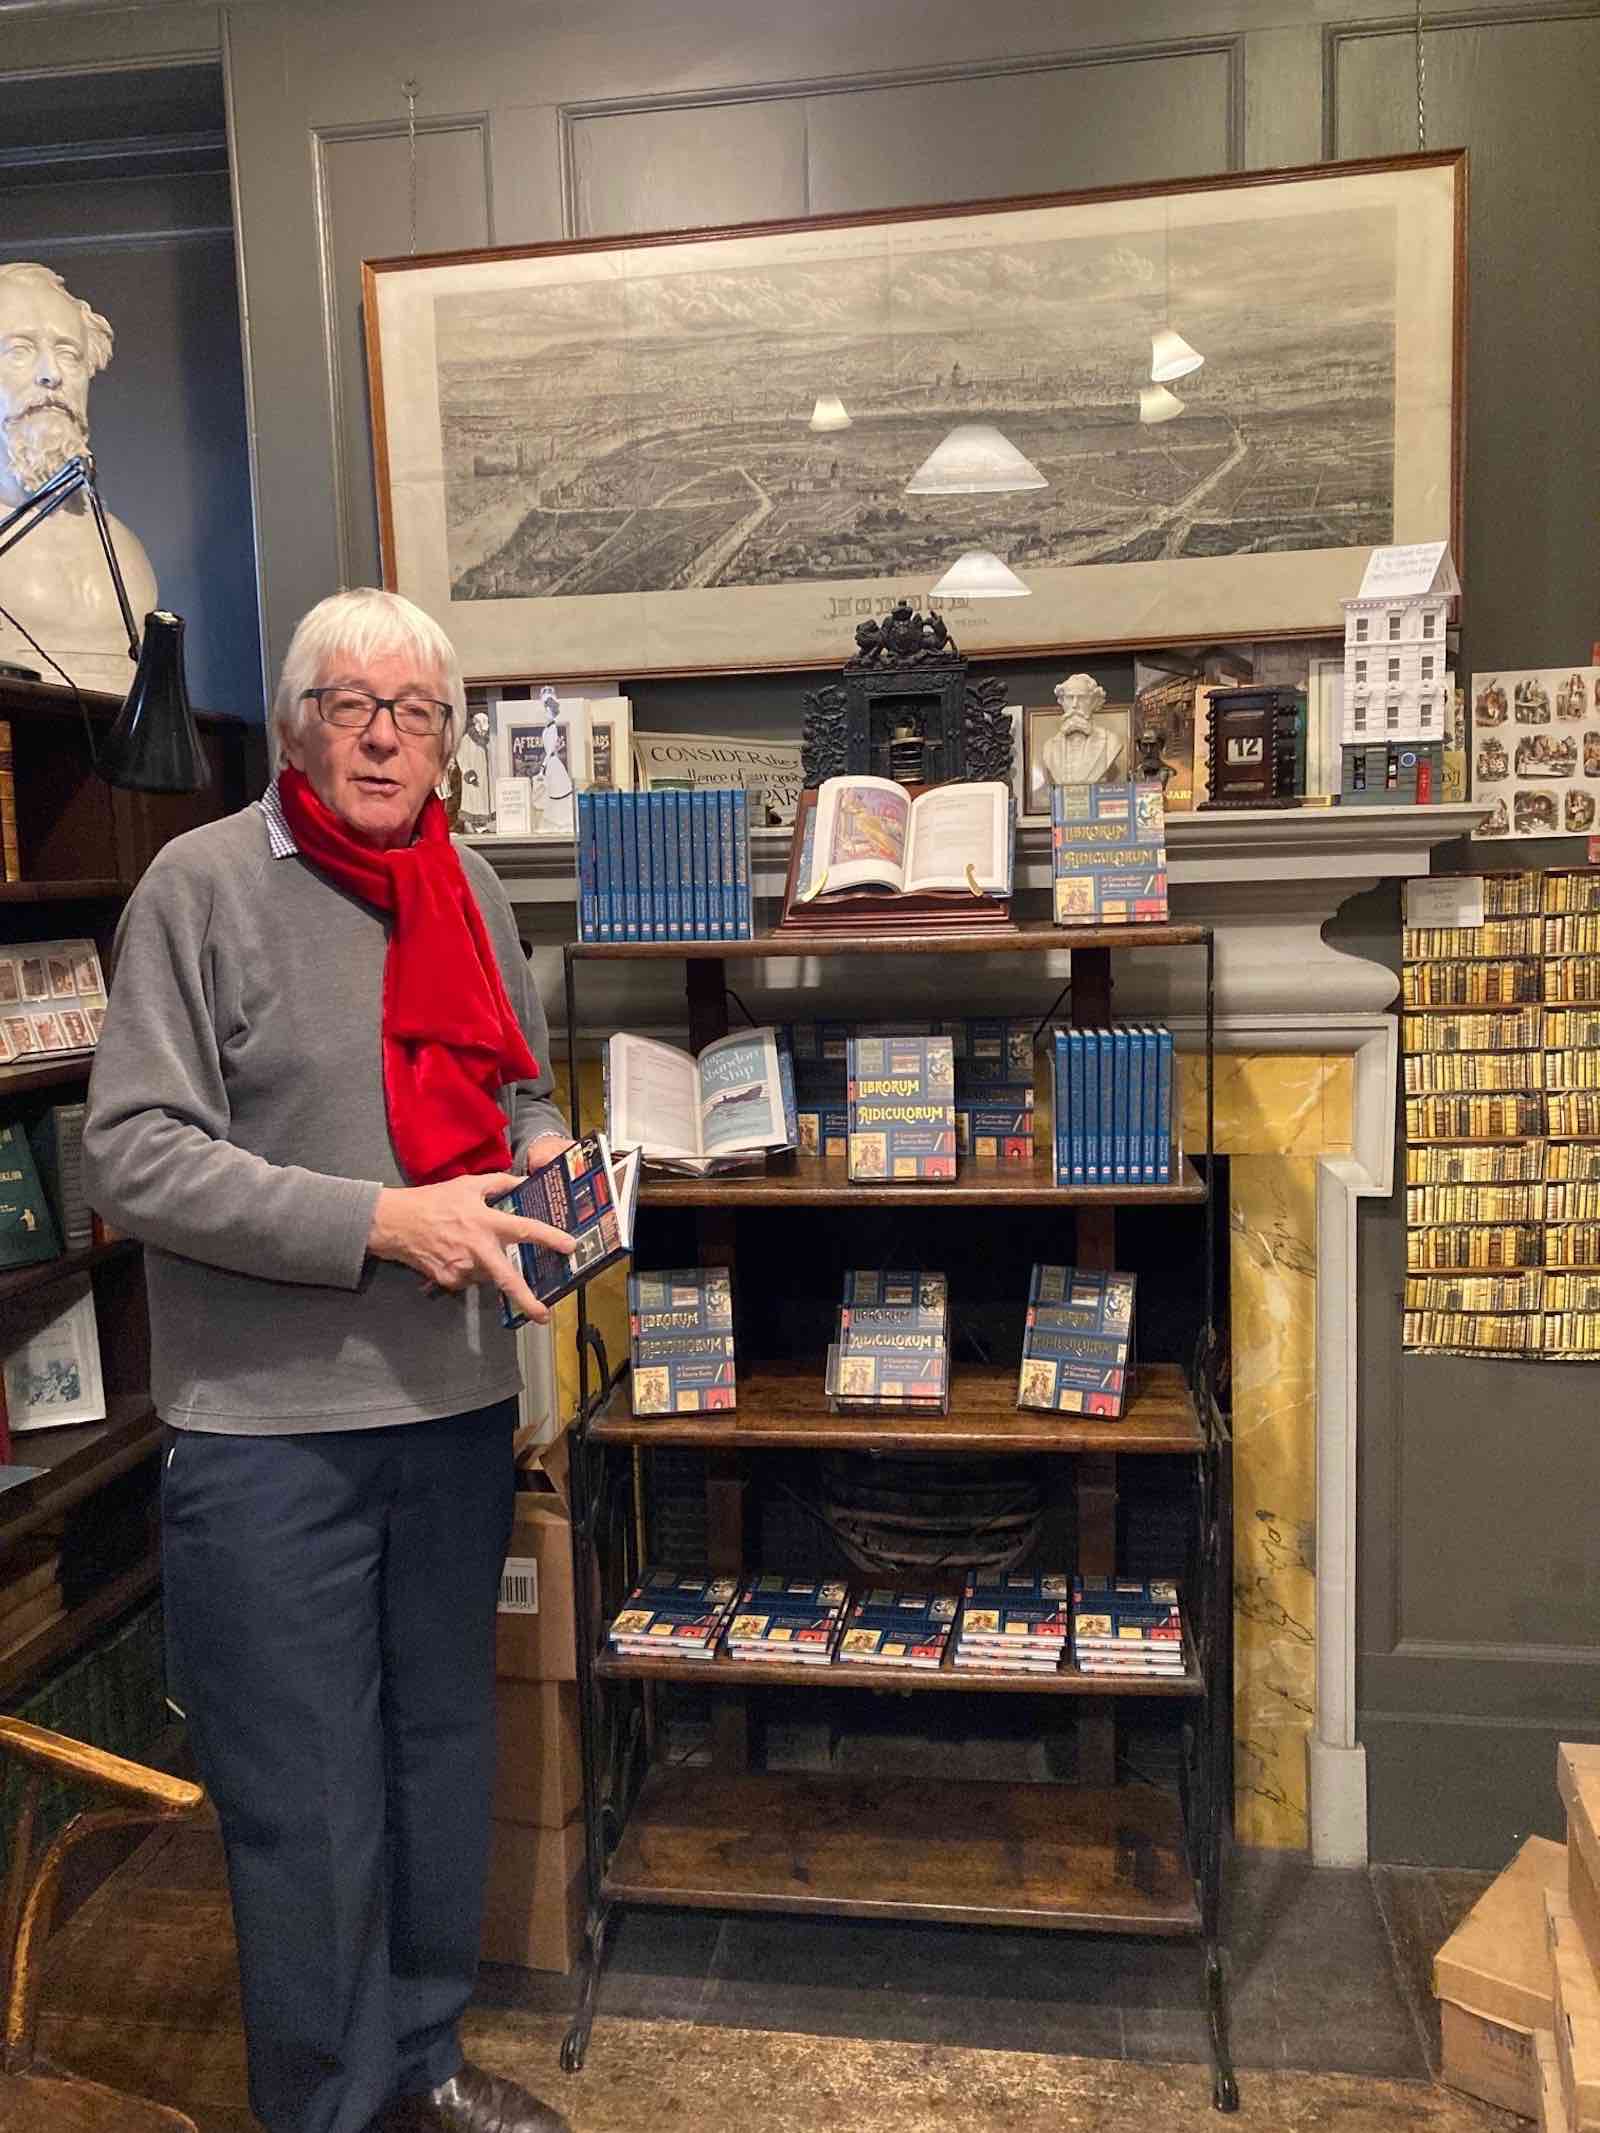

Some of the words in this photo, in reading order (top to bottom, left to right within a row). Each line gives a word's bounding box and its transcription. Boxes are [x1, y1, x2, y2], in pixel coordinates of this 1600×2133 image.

[651, 746, 765, 764] CONSIDER
[859, 1080, 920, 1098] LIBRORUM
[857, 1106, 944, 1125] RIDICULORUM
[640, 1311, 699, 1332] LIBRORUM
[850, 1333, 932, 1351] RIDICULORUM
